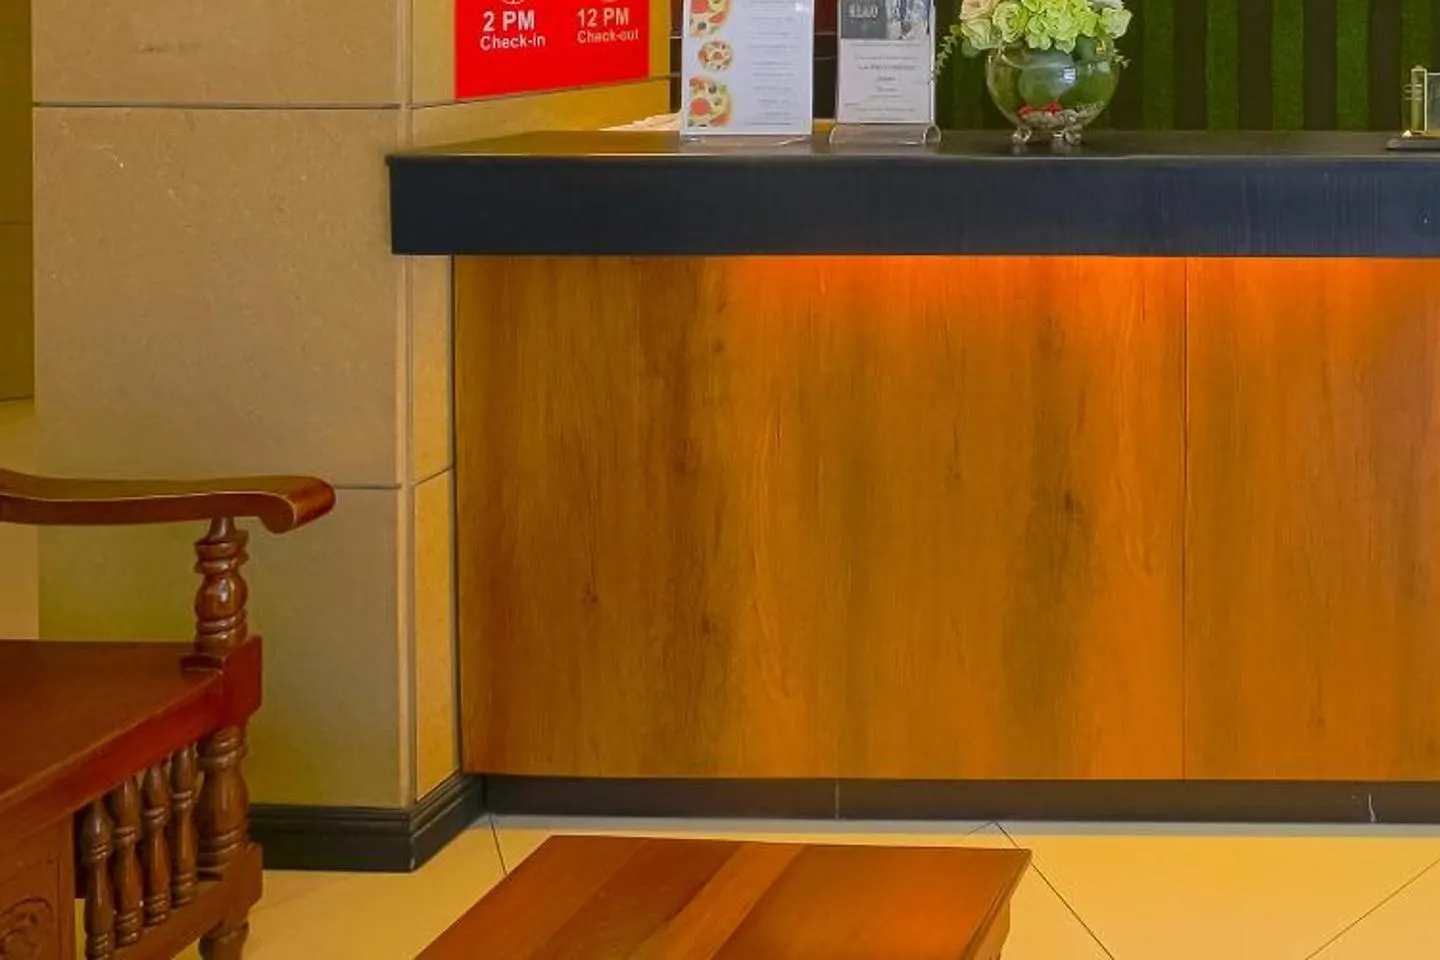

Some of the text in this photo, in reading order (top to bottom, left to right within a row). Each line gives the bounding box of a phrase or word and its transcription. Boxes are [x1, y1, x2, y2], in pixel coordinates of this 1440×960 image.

[482, 9, 536, 32] 2 PM
[577, 7, 629, 27] 12 PM
[479, 34, 546, 51] Check-in
[577, 28, 640, 44] Check-out
